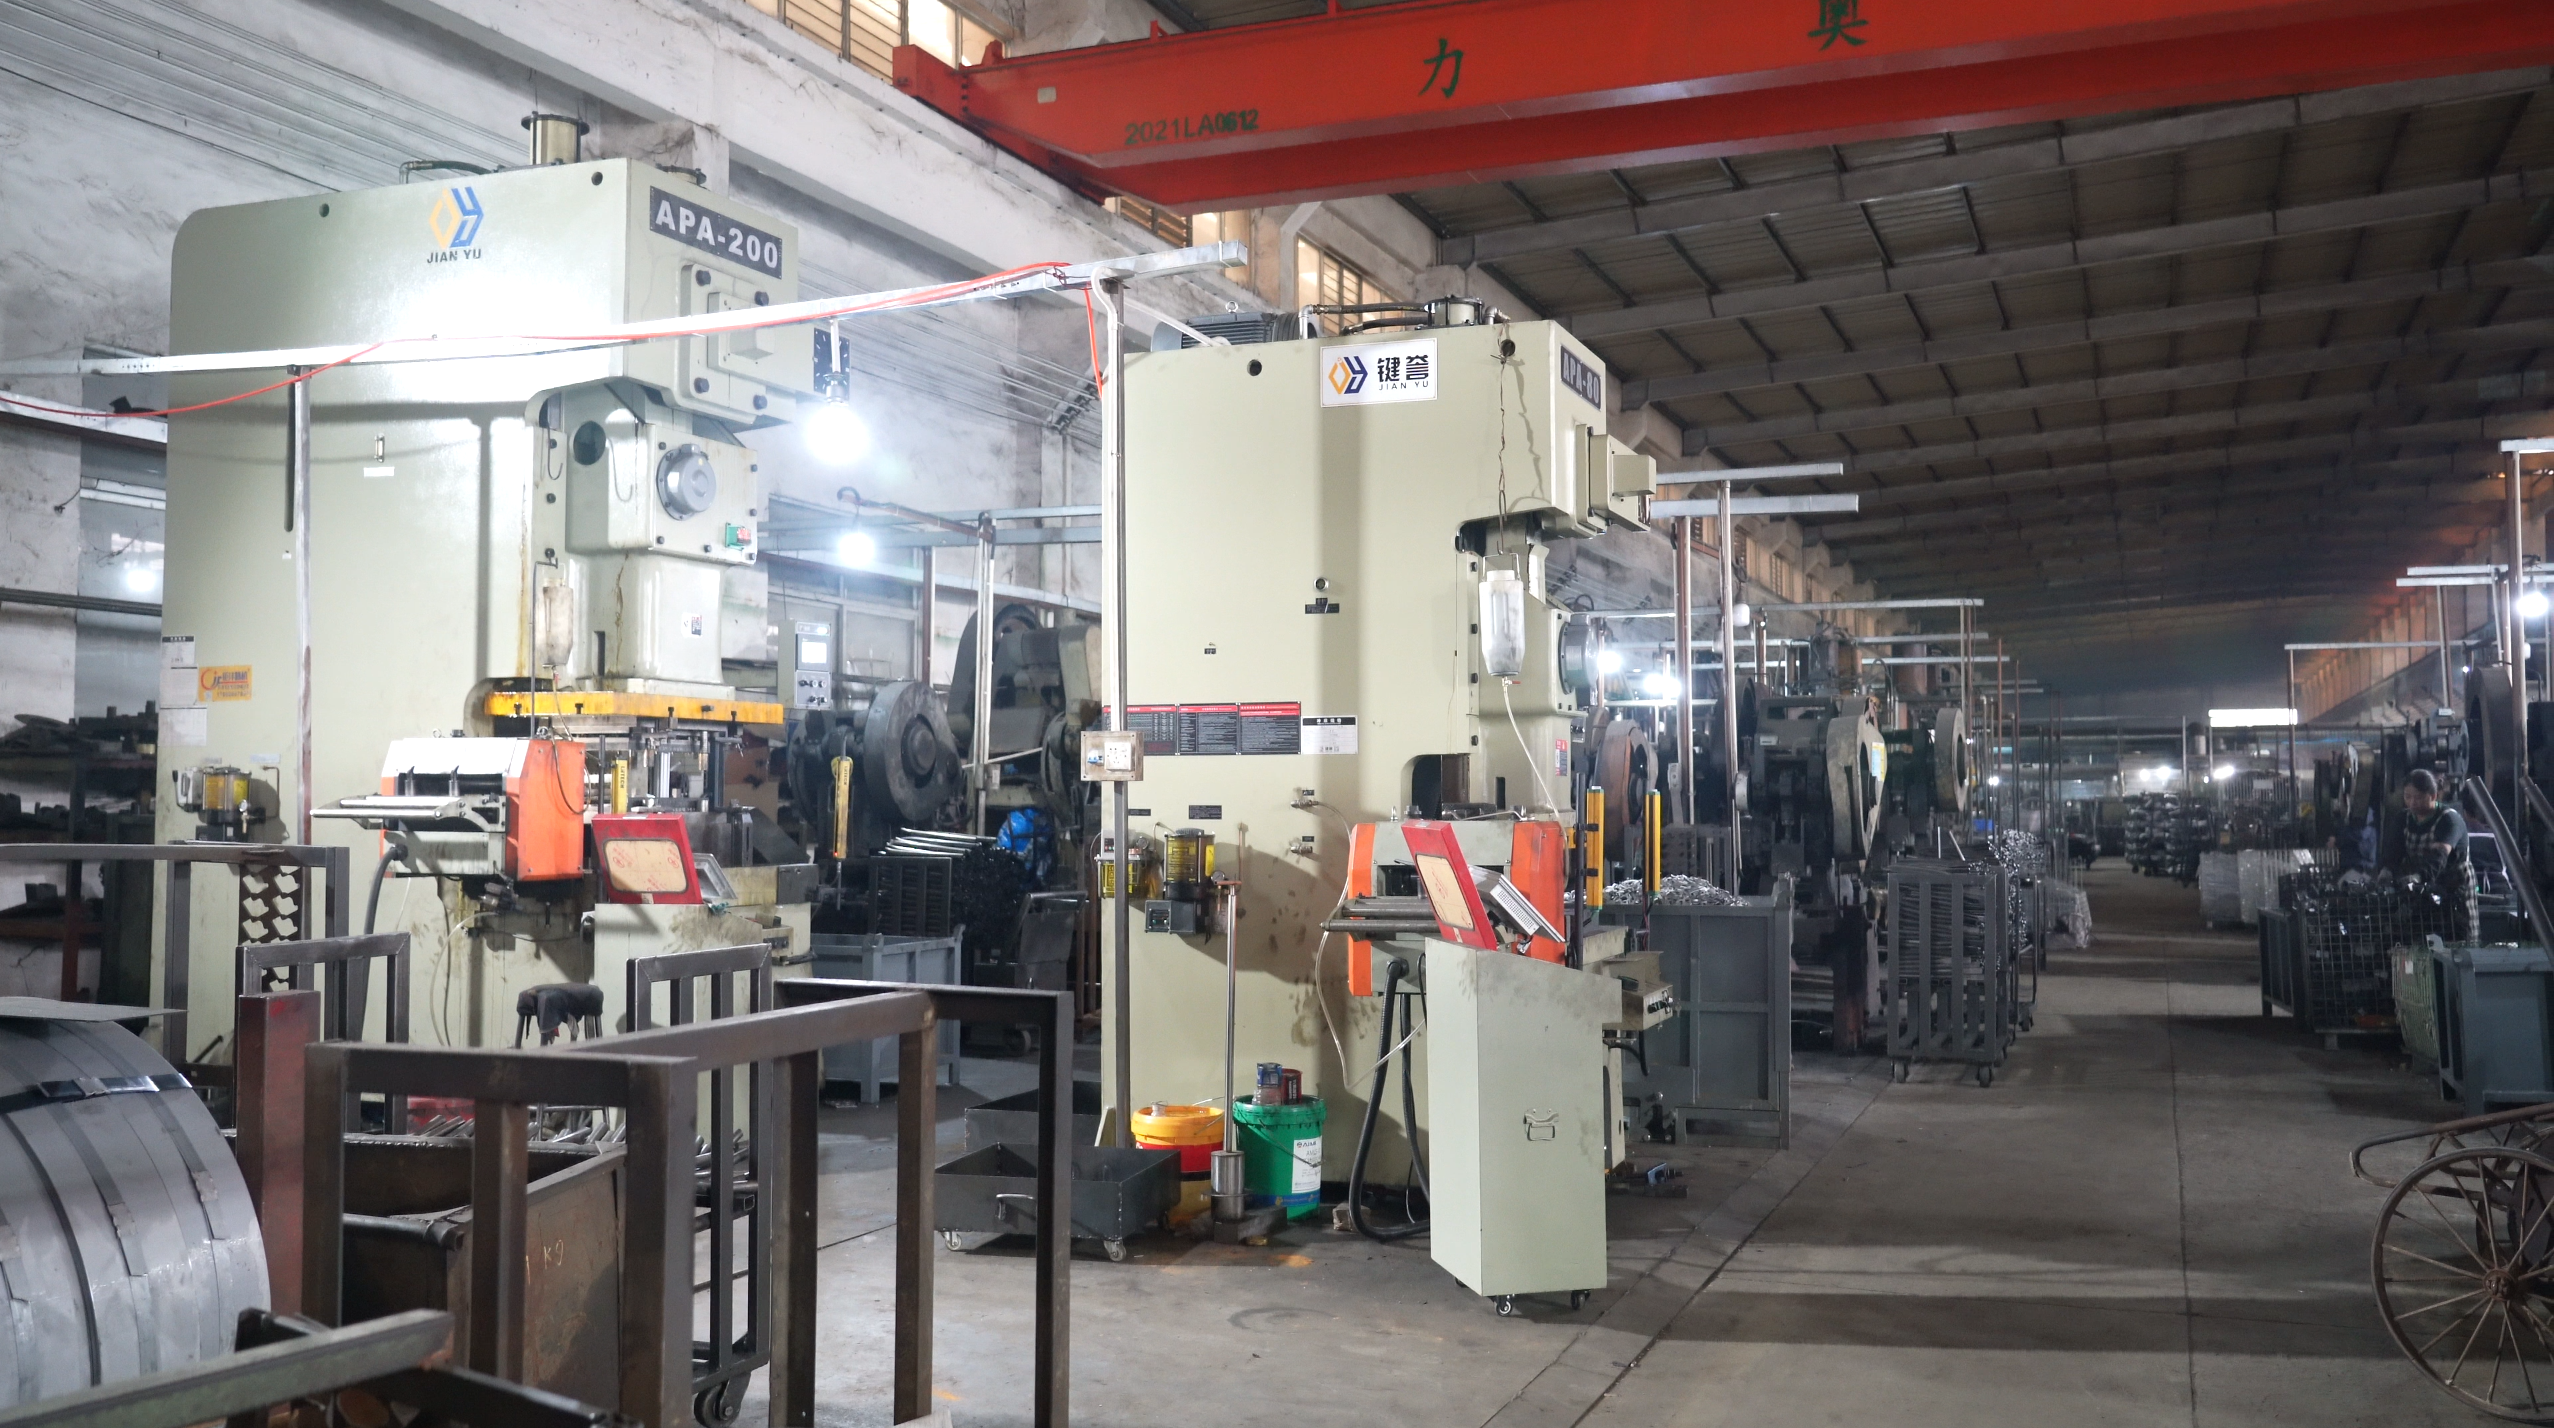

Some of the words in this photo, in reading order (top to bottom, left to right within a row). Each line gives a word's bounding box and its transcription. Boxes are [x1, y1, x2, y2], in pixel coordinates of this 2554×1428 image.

[1418, 38, 1464, 98] 力
[1124, 109, 1259, 145] 2021LA0612
[655, 199, 778, 269] APA-200
[427, 250, 458, 264] JIAN
[463, 248, 481, 260] YU
[1377, 355, 1429, 383] 键誉
[1379, 382, 1407, 391] JIAN
[1414, 380, 1429, 388] YU
[1563, 352, 1600, 404] APA-80
